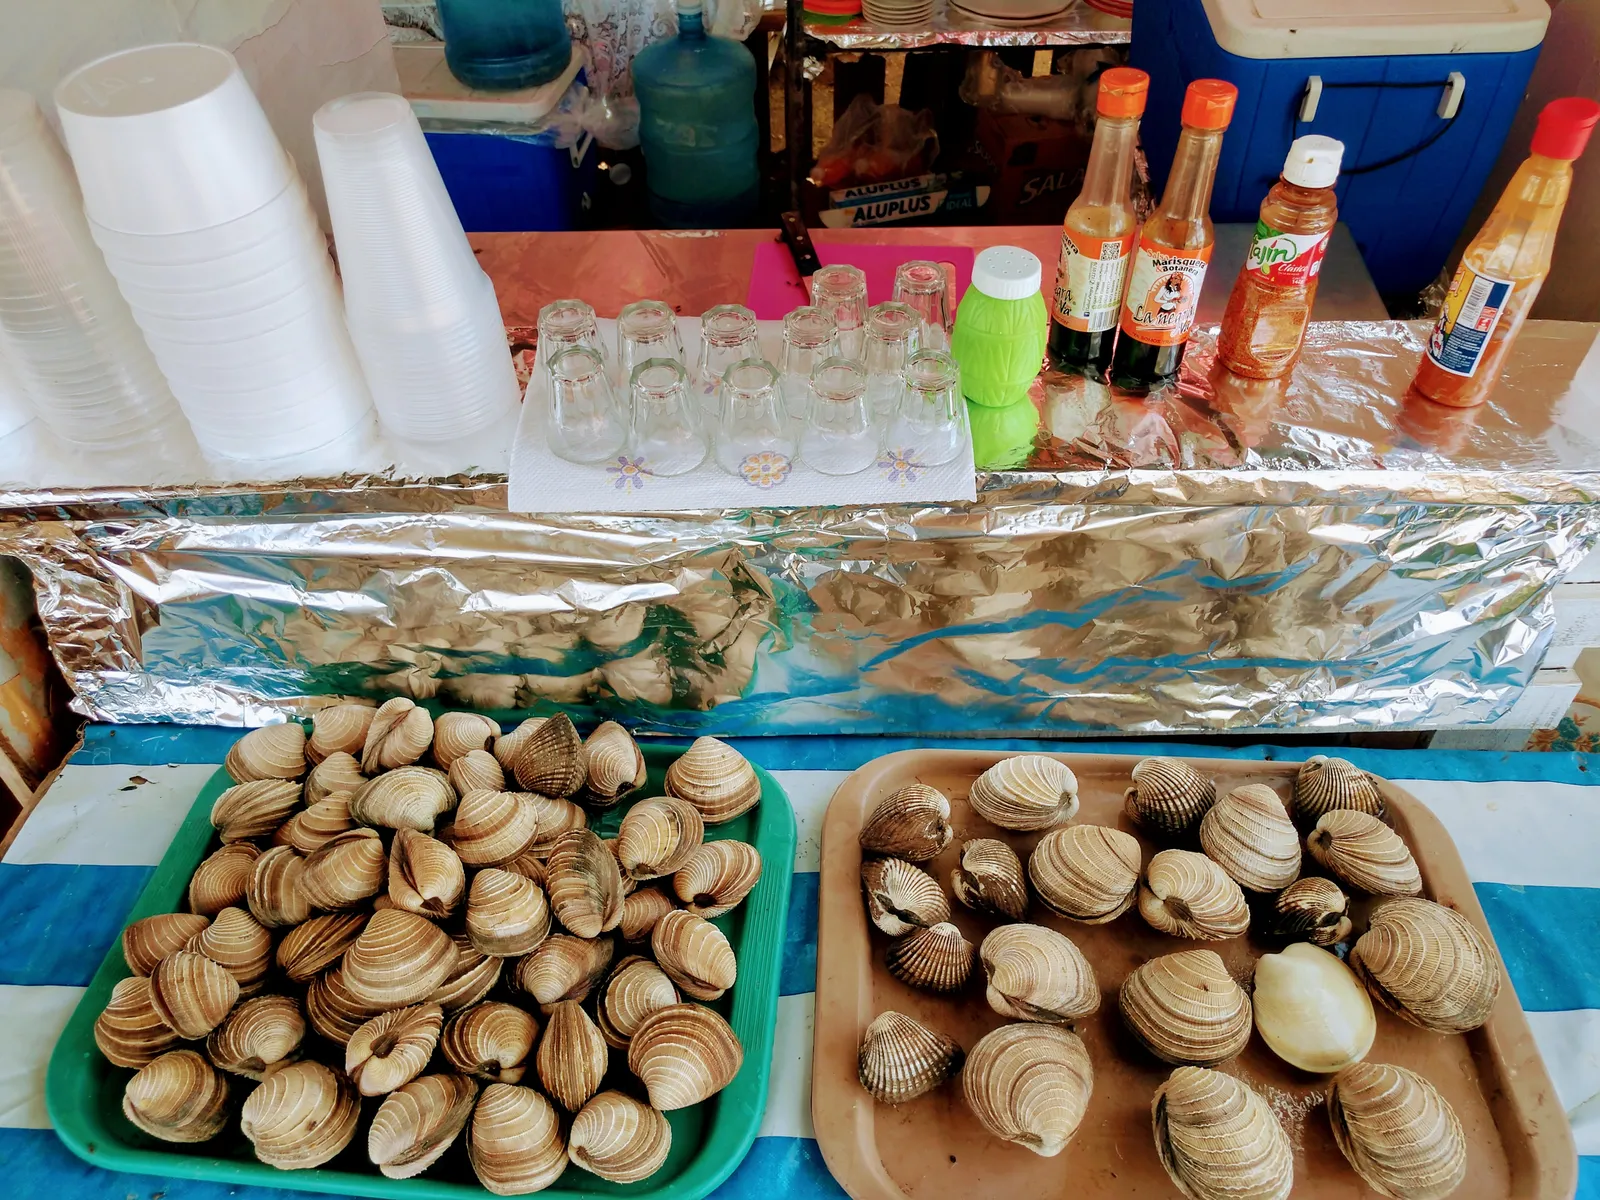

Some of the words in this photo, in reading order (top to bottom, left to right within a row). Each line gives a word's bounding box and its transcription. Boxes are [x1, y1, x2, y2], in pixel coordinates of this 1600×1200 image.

[845, 177, 921, 198] ALUPLUS
[853, 195, 931, 222] ALUPLUS
[1152, 256, 1206, 269] Marisquera
[1163, 265, 1199, 276] Botanera
[1133, 305, 1152, 324] La
